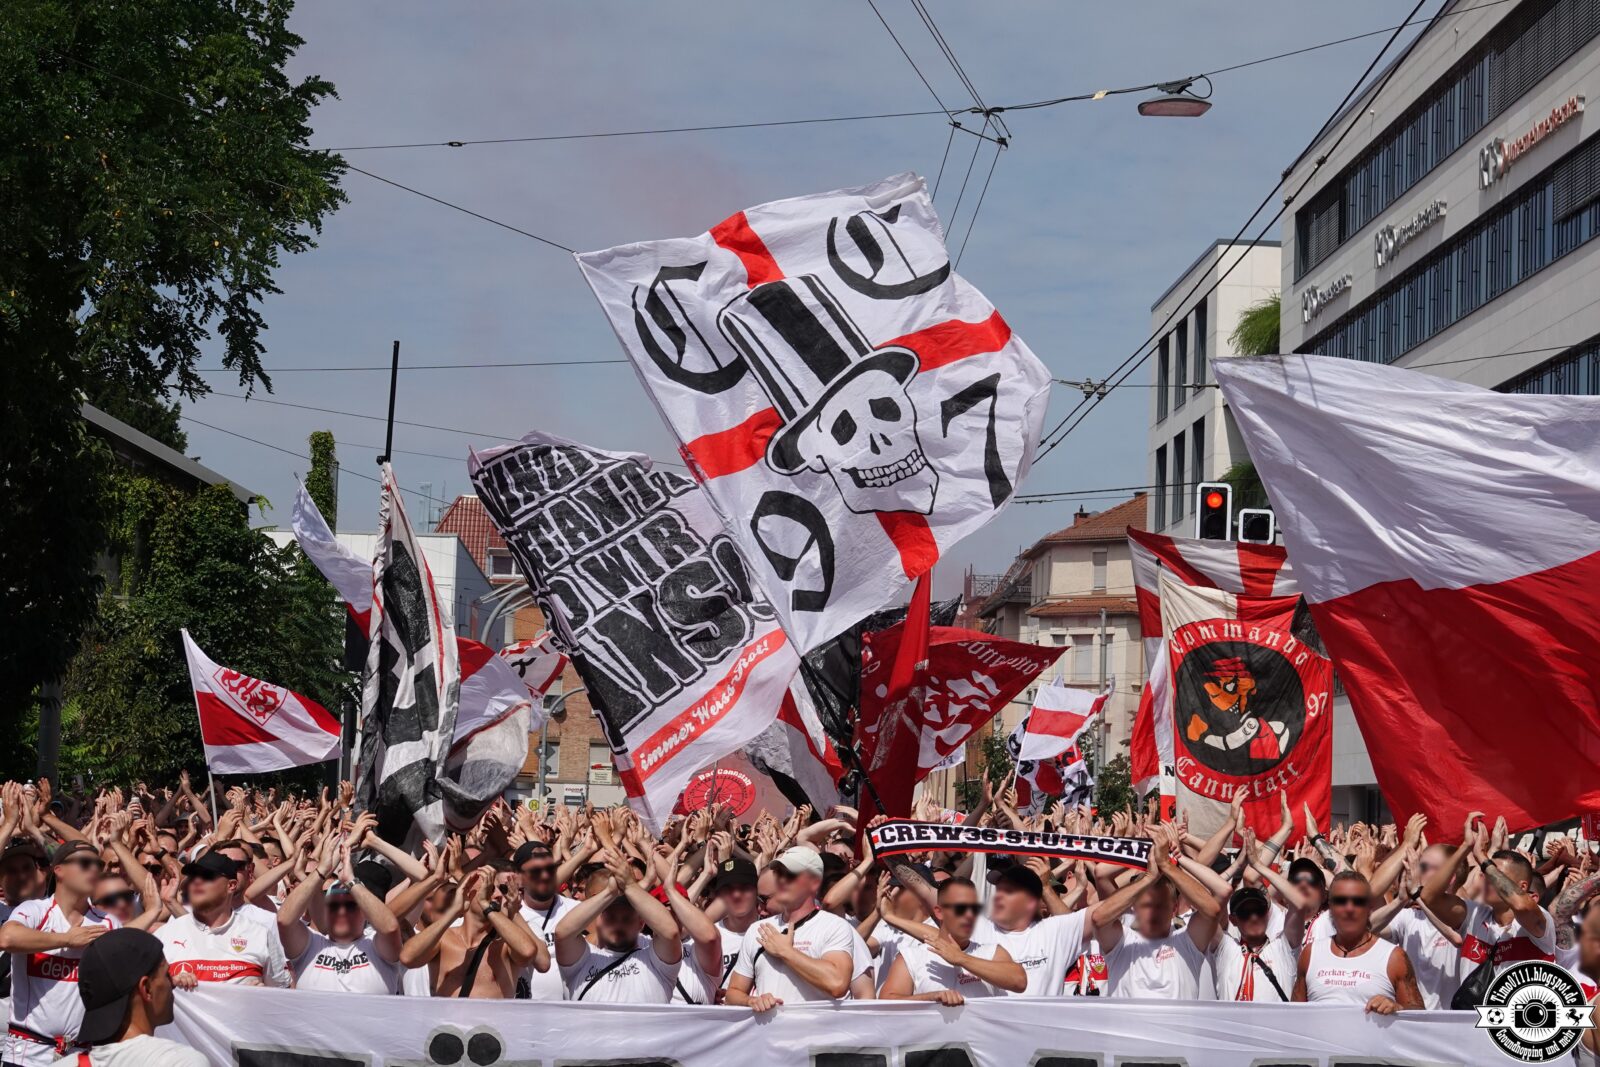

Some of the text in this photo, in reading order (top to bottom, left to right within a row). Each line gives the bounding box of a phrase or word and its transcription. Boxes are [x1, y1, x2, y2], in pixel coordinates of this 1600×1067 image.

[940, 372, 1013, 510] 7
[1169, 621, 1308, 665] Commando
[1306, 691, 1329, 717] 97
[639, 720, 695, 771] immer
[1005, 829, 1152, 861] STUTTGAR
[41, 957, 79, 979] debi
[1324, 979, 1357, 987] Stuttgart
